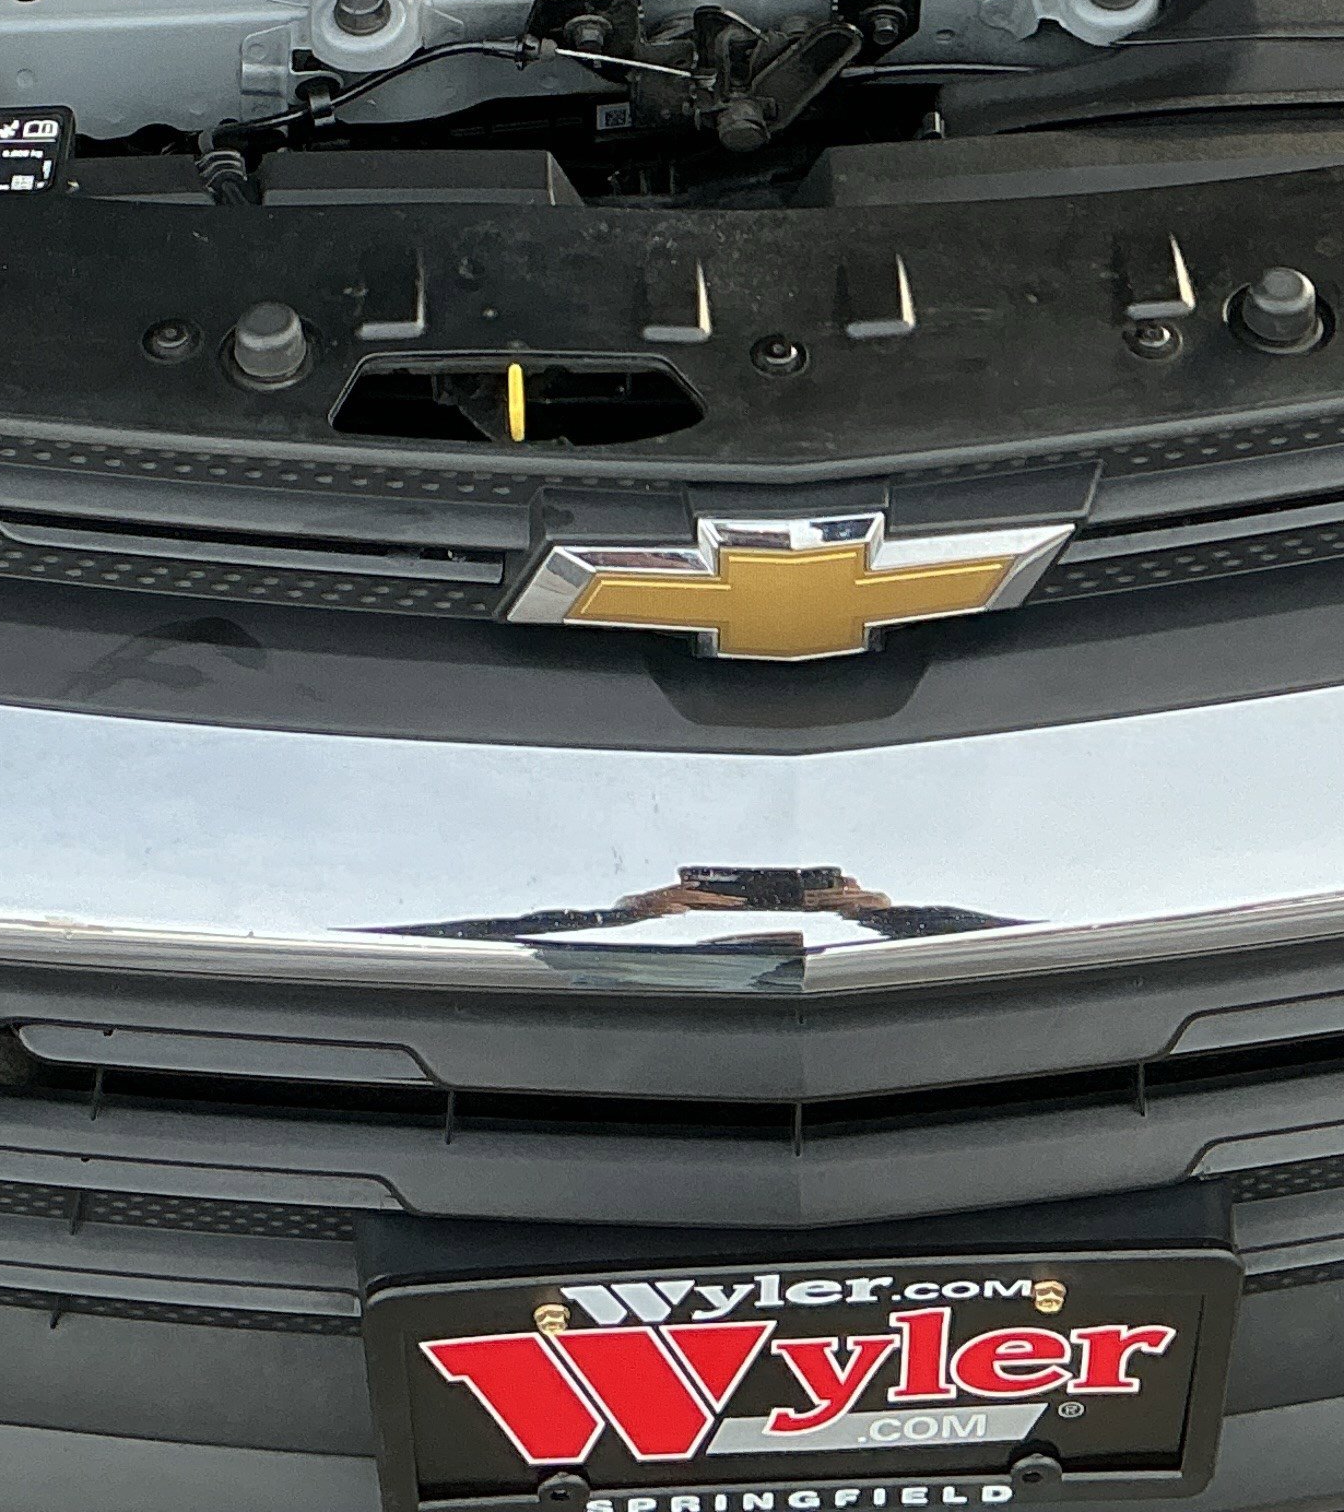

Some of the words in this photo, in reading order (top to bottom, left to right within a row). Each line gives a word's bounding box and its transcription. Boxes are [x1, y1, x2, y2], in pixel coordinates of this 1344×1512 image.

[419, 1307, 1178, 1465] Wyler
[856, 1412, 988, 1443] .COM
[587, 1485, 1014, 1512] SPRINGFIELD
